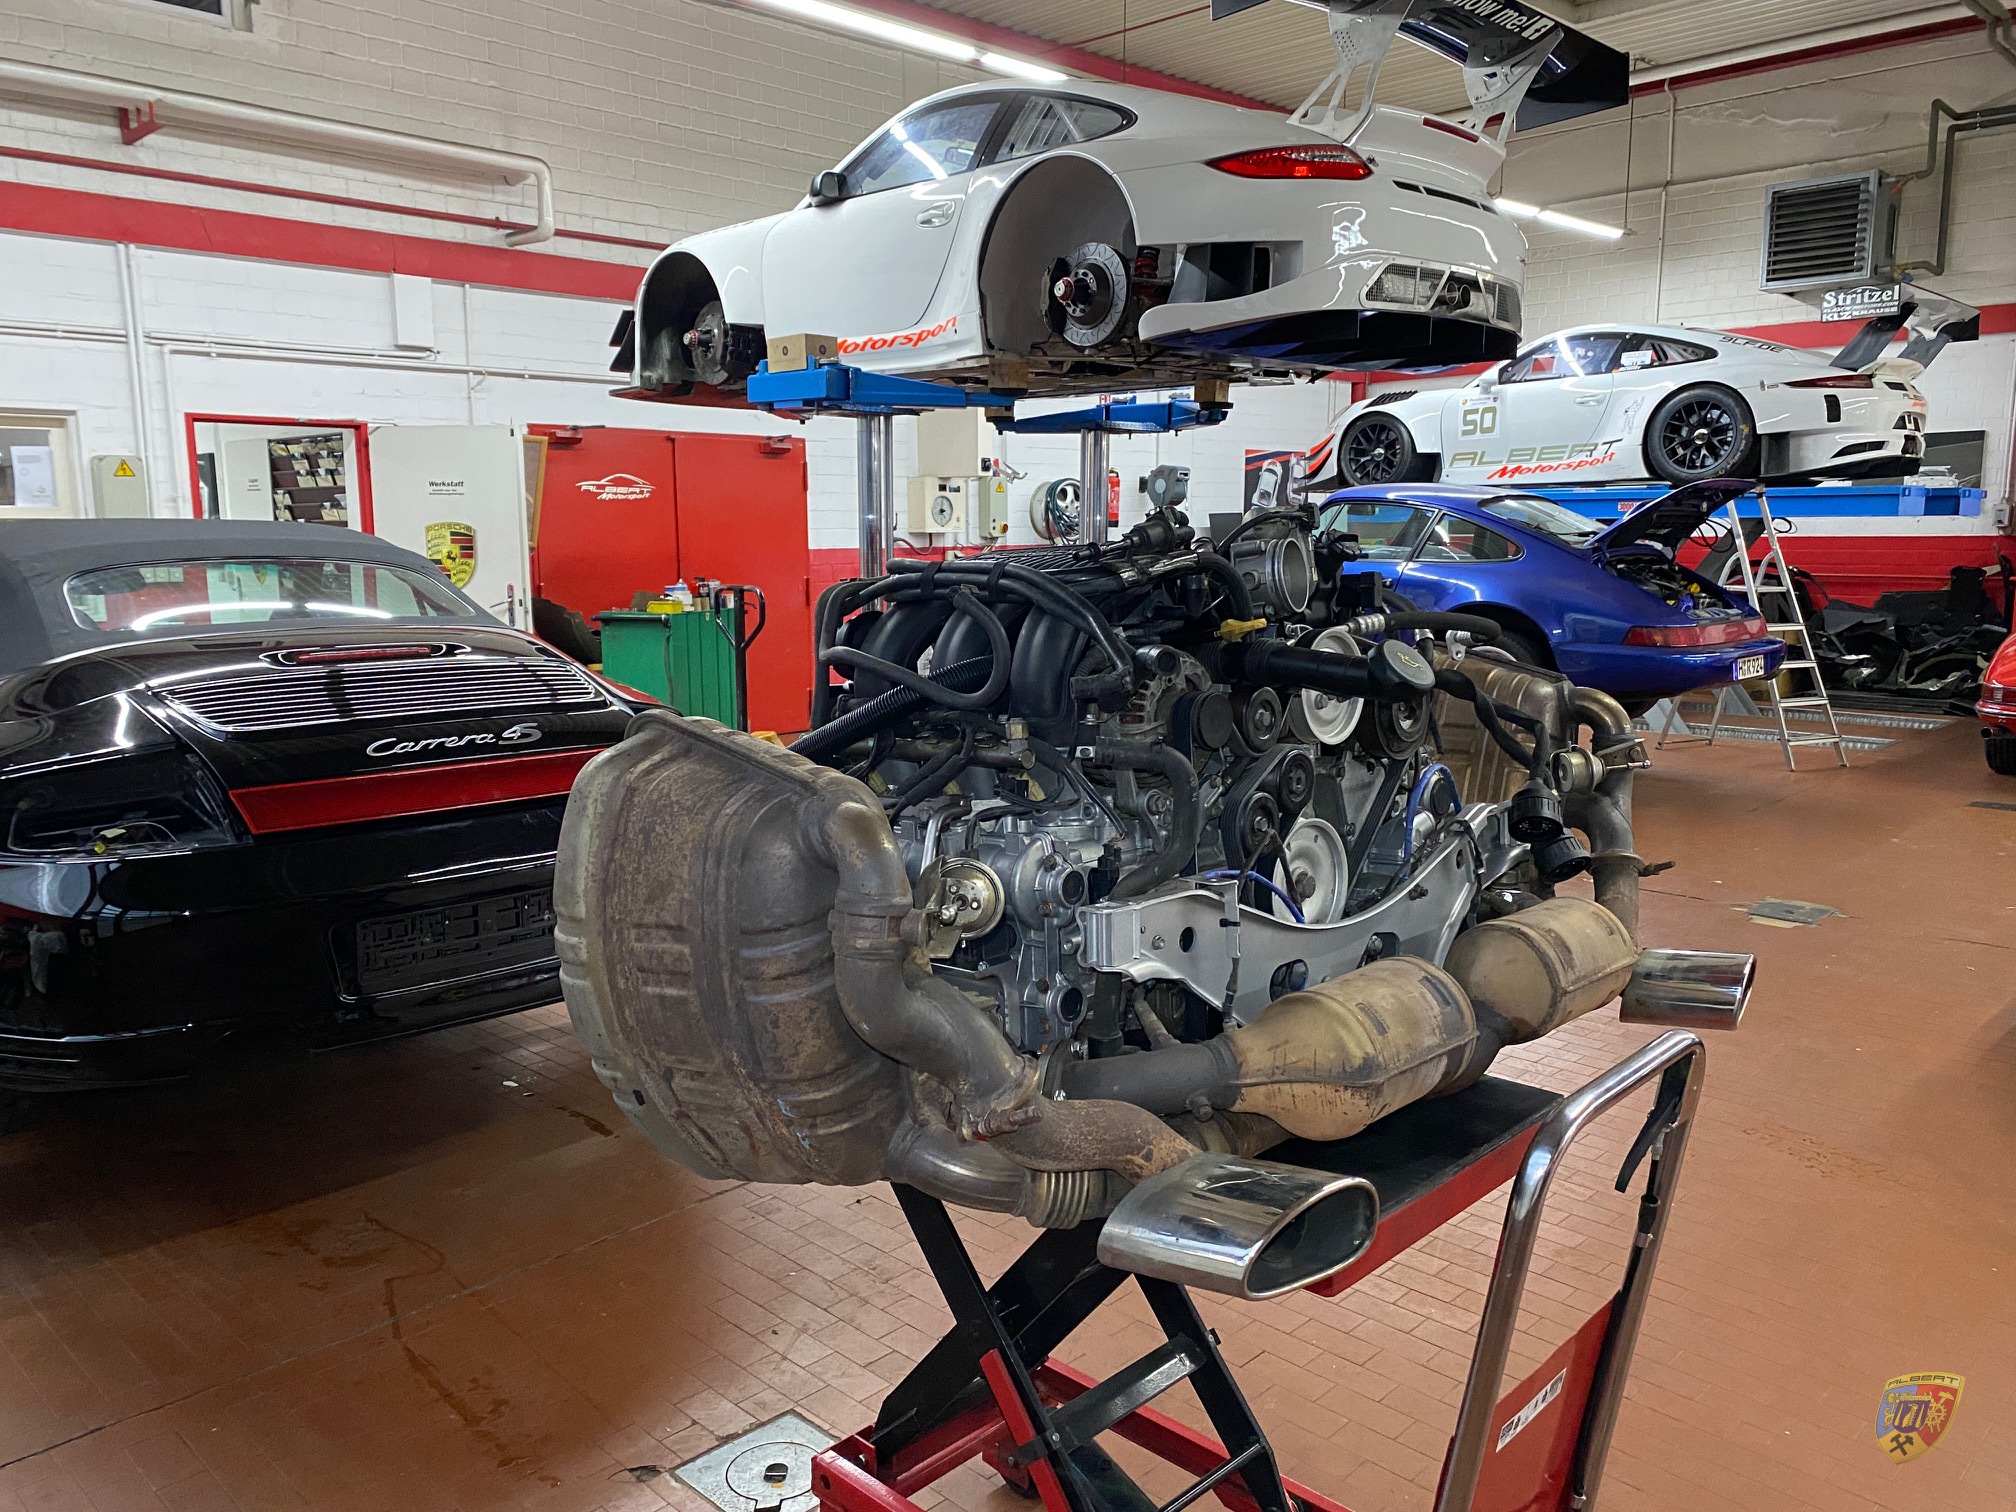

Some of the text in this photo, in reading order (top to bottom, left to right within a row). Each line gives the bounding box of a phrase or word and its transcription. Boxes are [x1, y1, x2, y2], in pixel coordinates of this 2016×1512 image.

[1489, 8, 1541, 32] me!
[1822, 284, 1900, 308] Stritzel
[1822, 311, 1852, 323] KLZ
[1461, 405, 1498, 437] 50
[1449, 438, 1624, 468] ALBERT
[1487, 452, 1617, 480] Motorsport
[580, 485, 652, 494] ALBERT
[596, 492, 651, 501] Motorsport
[425, 523, 473, 534] PORSCHE
[366, 722, 542, 757] Carrera 4S
